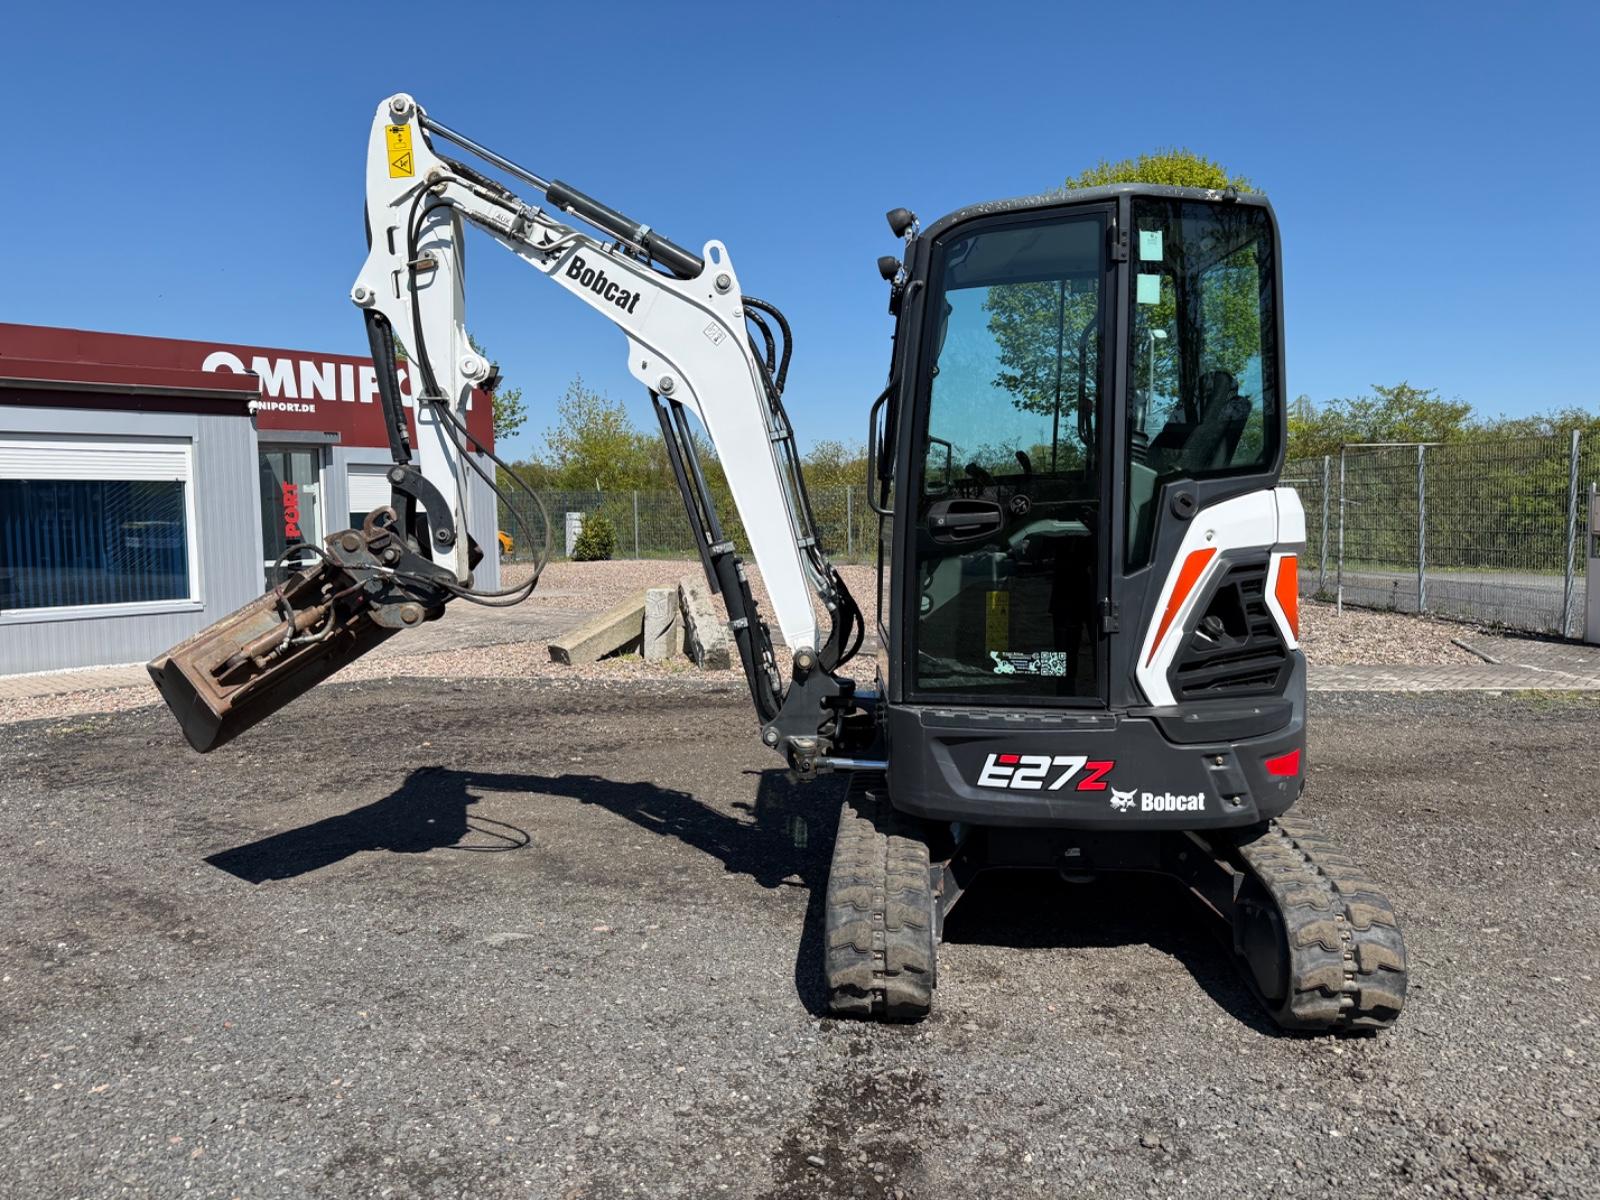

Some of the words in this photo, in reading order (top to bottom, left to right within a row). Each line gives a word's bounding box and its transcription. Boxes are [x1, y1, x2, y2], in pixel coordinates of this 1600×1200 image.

[565, 254, 641, 315] Bobcat
[257, 400, 316, 413] NIPORT.DE
[1141, 792, 1206, 813] Bobcat
